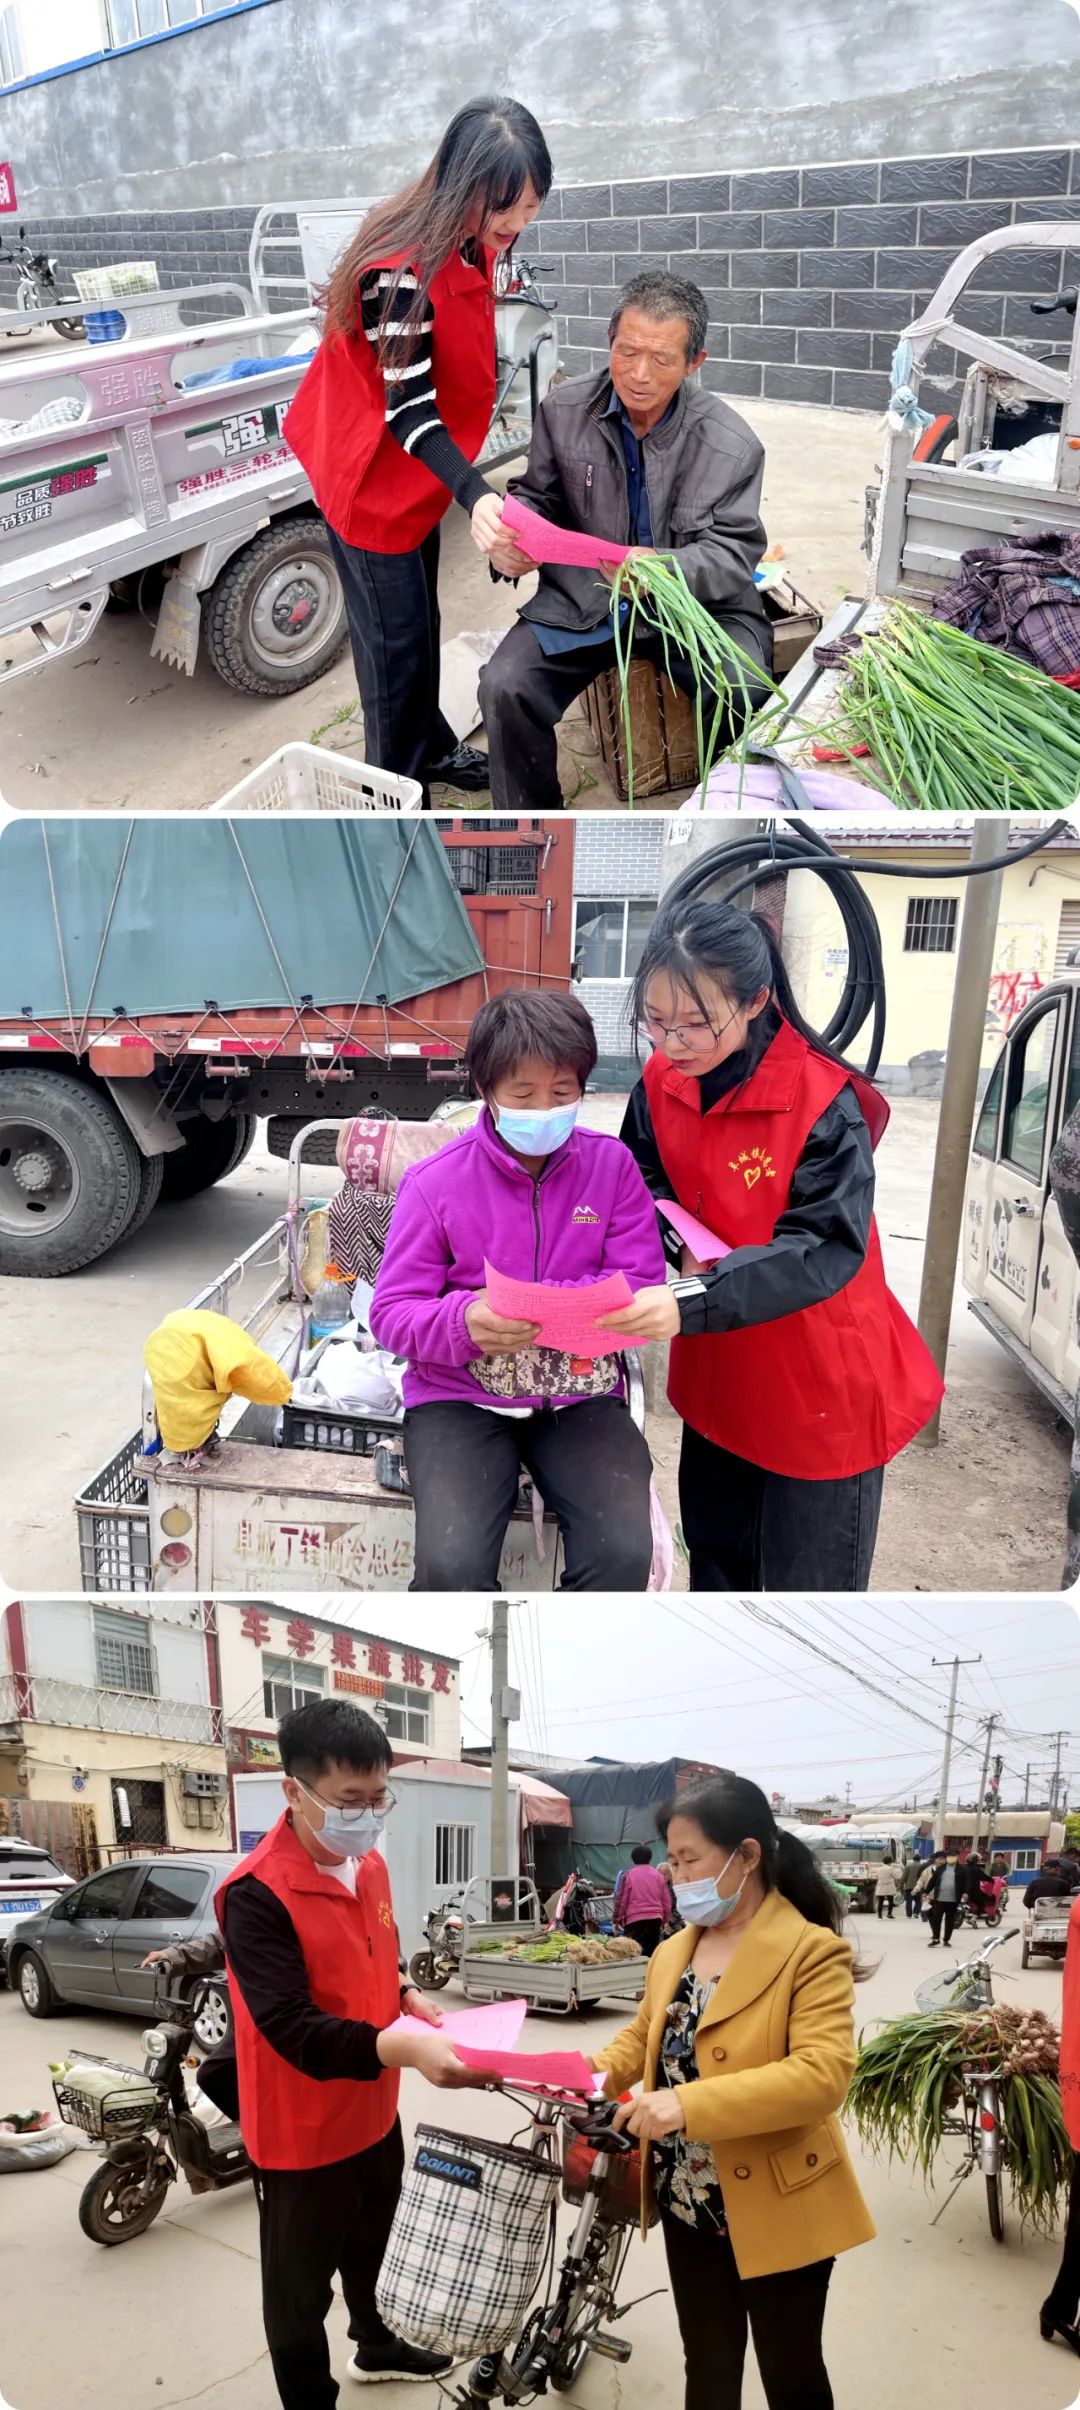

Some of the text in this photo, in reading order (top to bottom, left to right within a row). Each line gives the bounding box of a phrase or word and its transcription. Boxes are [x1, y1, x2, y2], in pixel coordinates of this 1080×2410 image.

[240, 1605, 451, 1694] 车学果蔬批发
[427, 2157, 476, 2181] GIANT
